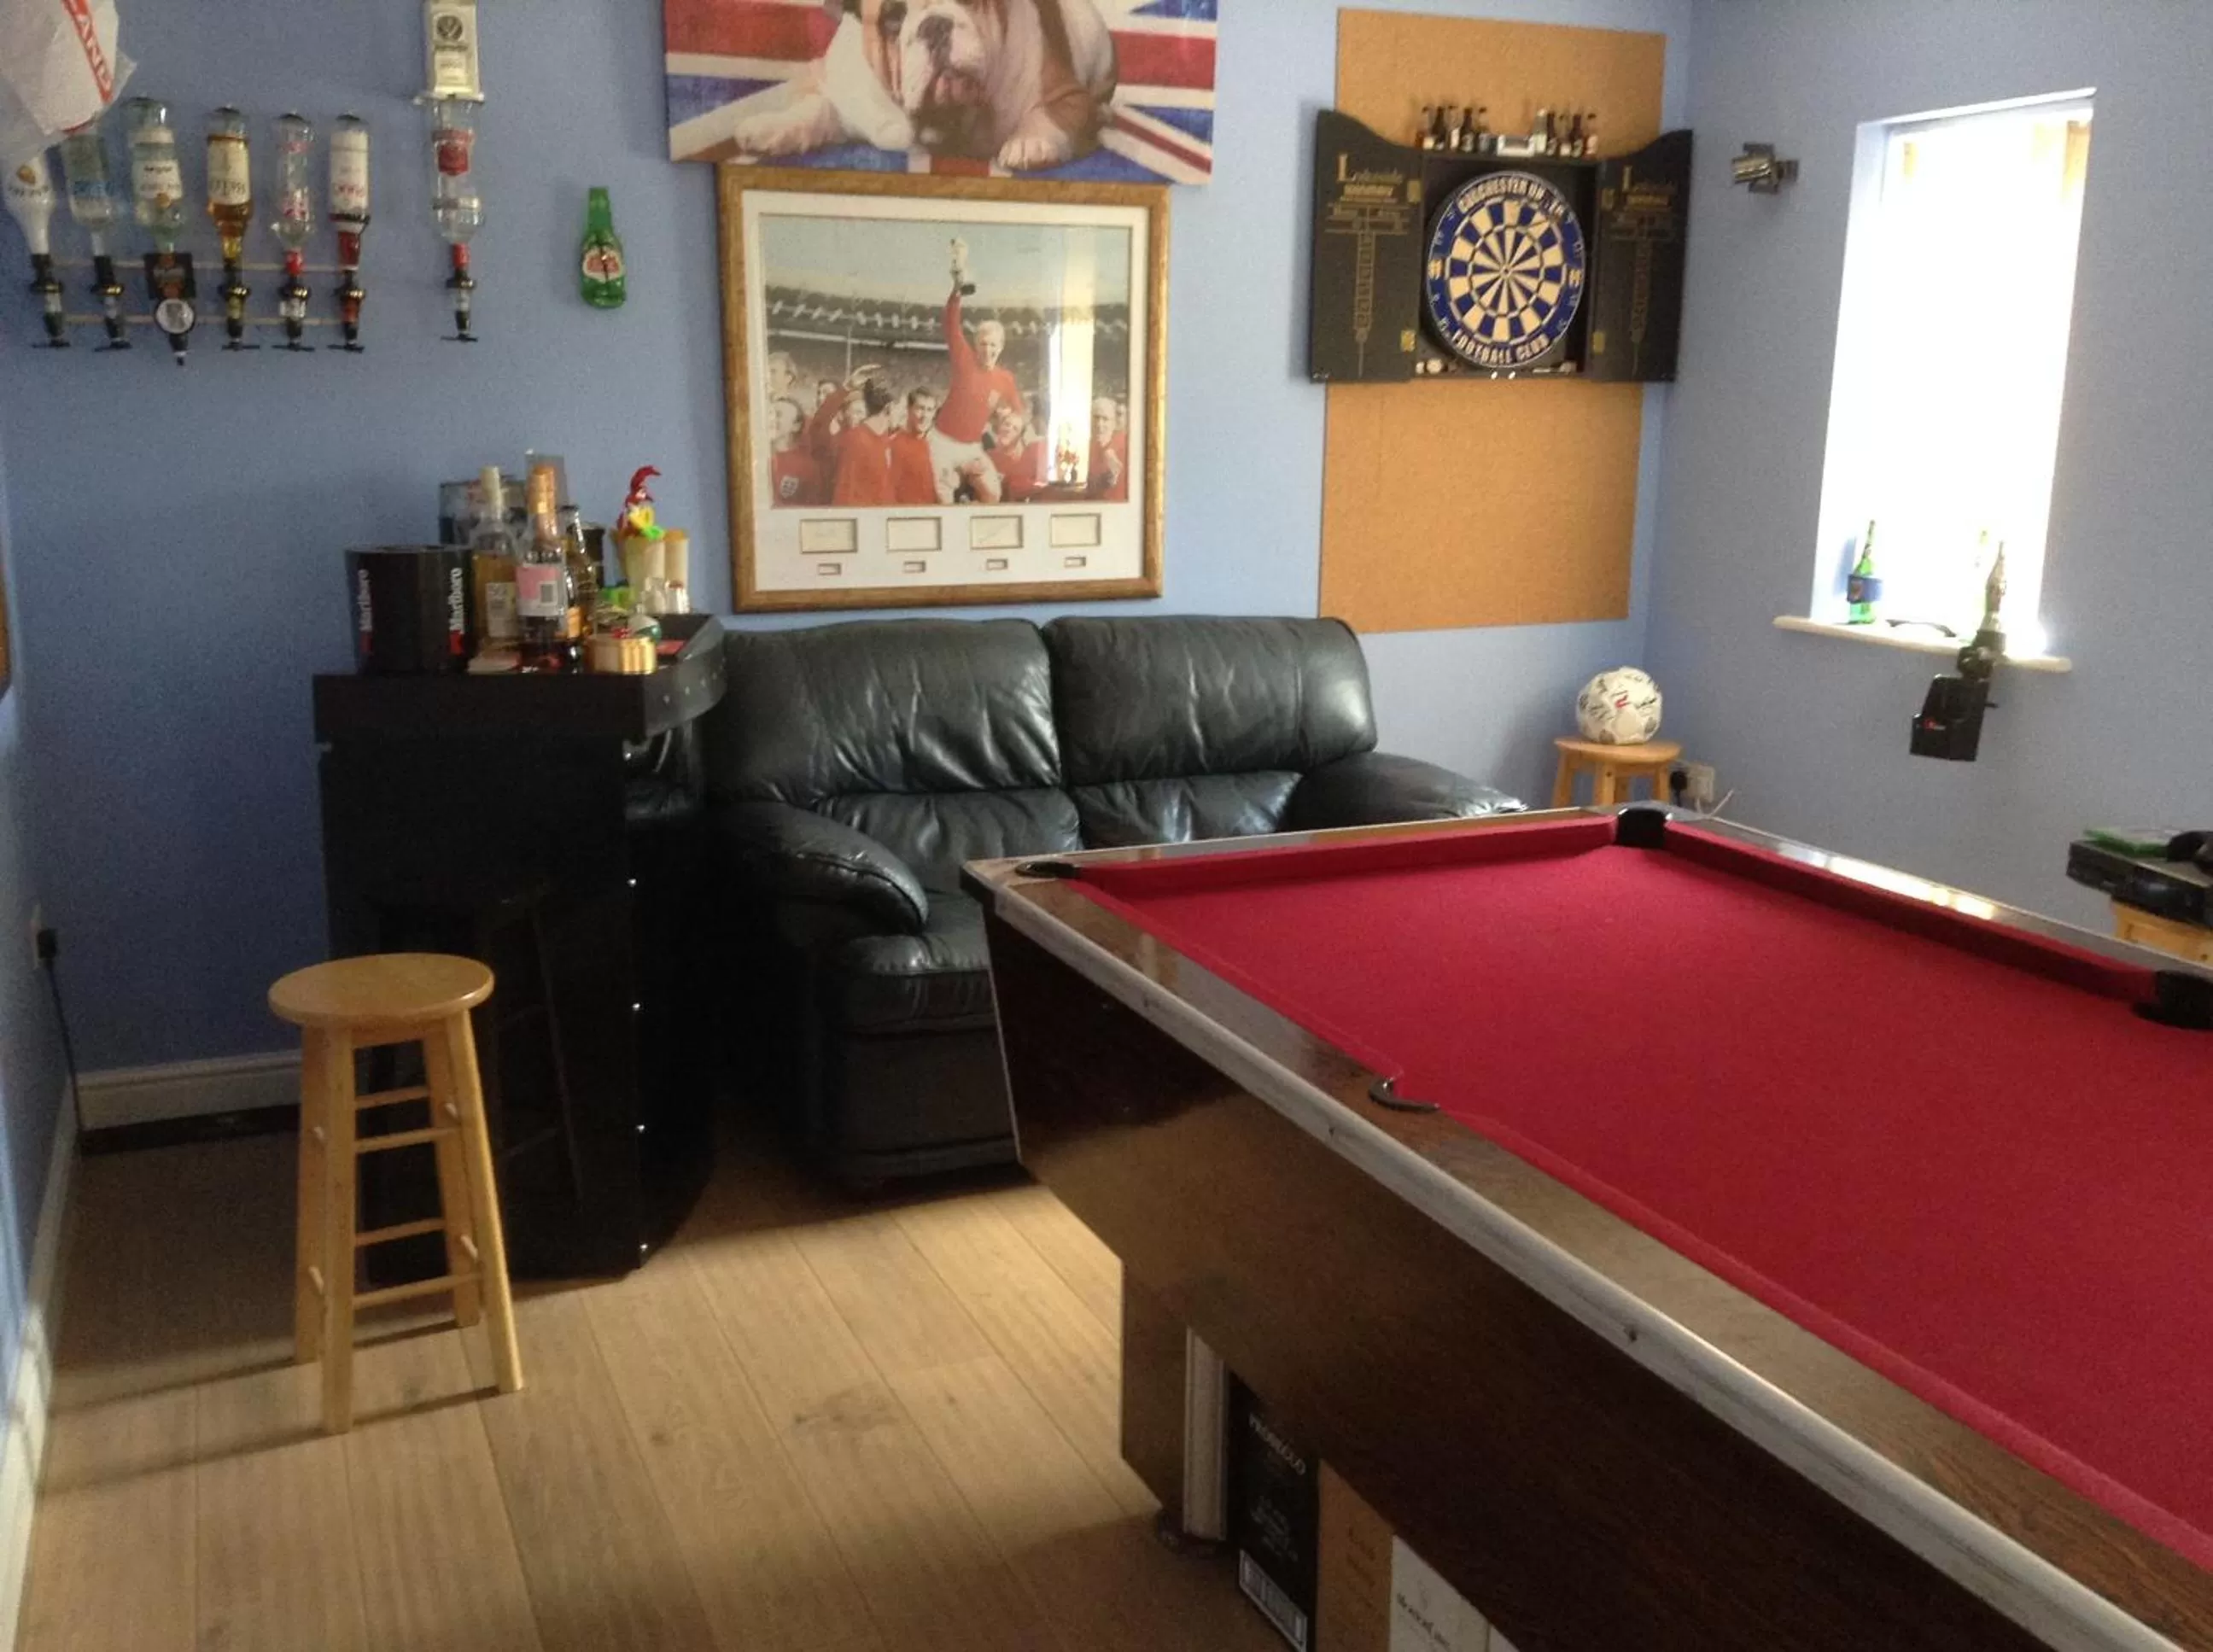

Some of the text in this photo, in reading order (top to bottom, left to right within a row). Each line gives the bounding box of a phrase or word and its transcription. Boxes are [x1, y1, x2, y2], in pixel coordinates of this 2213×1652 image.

[1452, 328, 1550, 364] FOOTBALL CLUB
[357, 569, 373, 632] Marlboro
[447, 567, 464, 634] Marlboro
